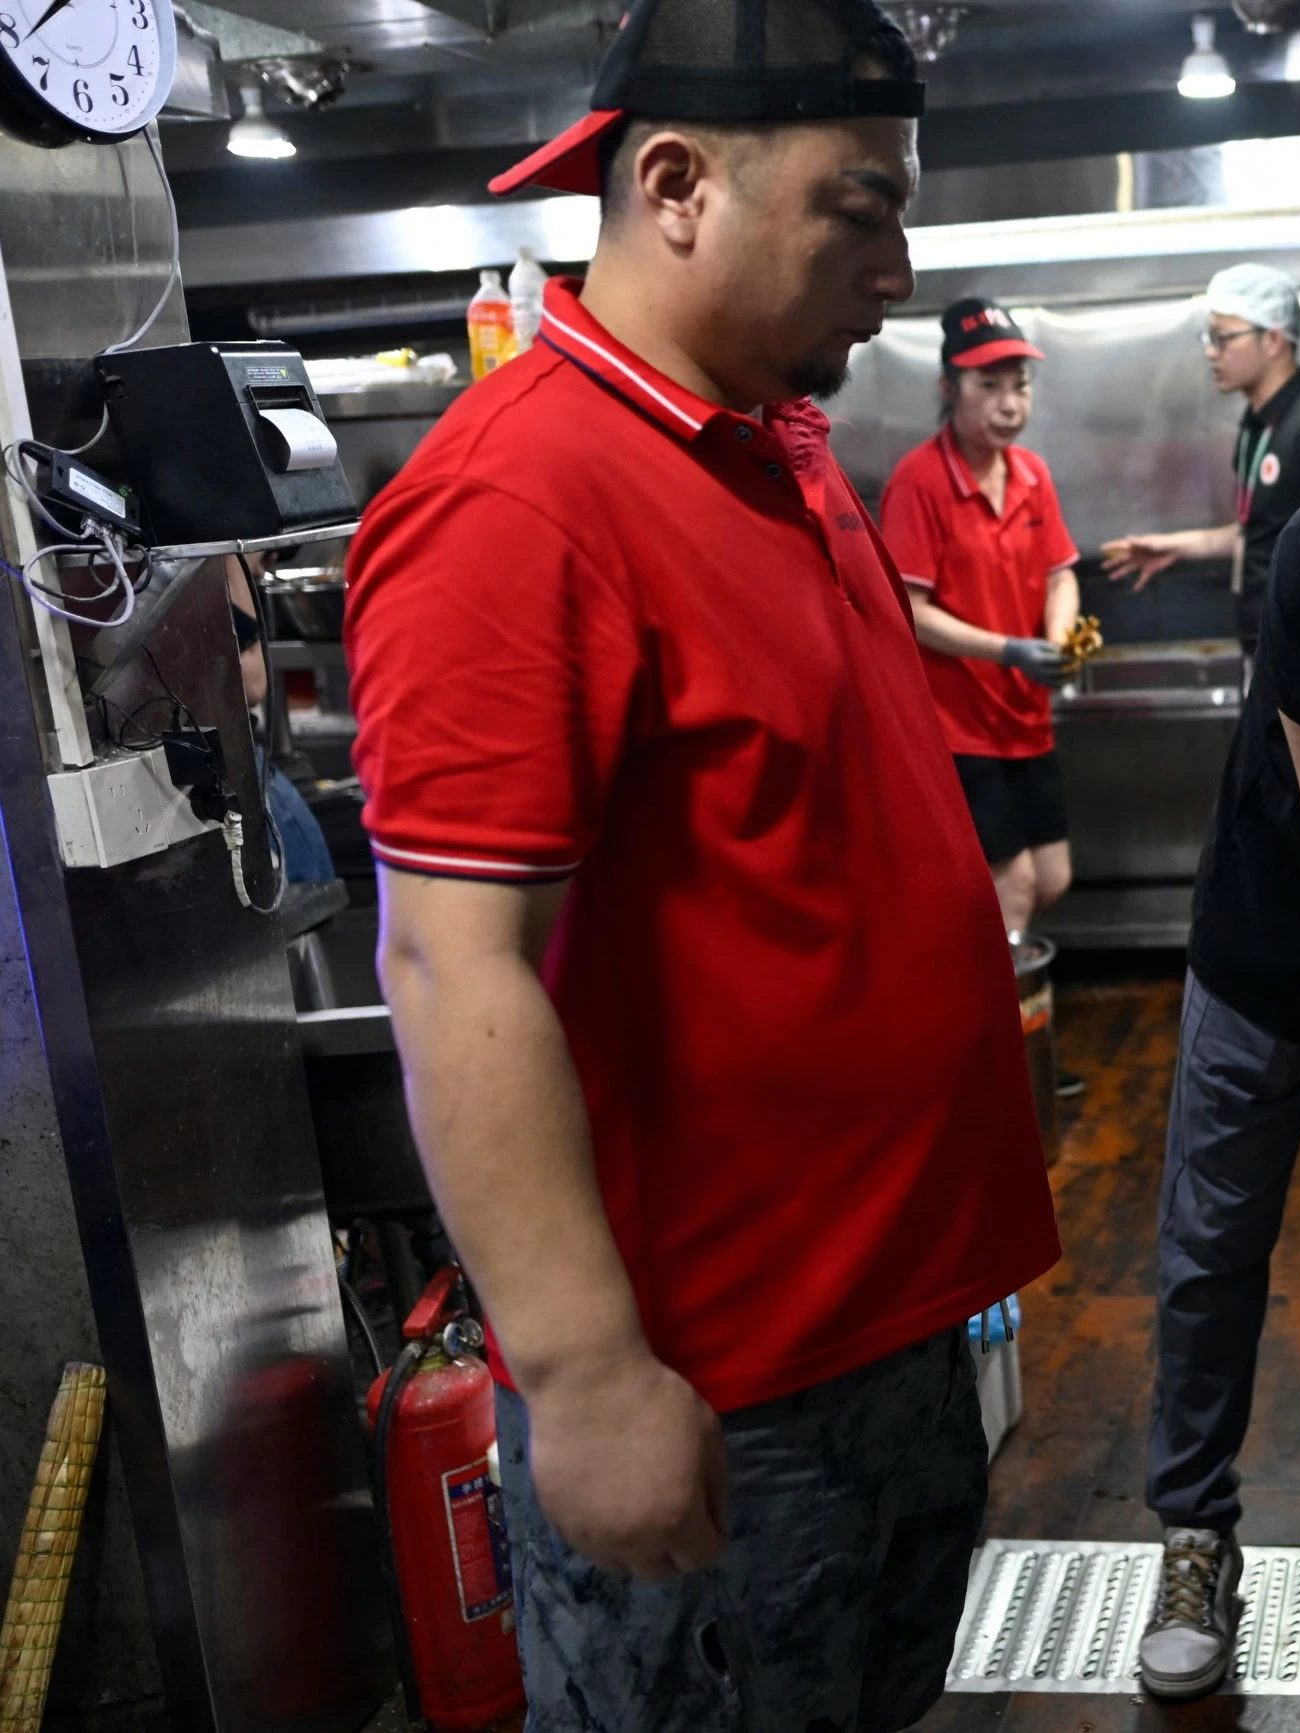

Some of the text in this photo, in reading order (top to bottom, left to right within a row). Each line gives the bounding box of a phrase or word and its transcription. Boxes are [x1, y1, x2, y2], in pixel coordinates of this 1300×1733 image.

[0, 13, 20, 49] 8
[130, 0, 149, 30] 3
[32, 54, 50, 91] 7
[127, 44, 145, 77] 4
[73, 79, 93, 113] 6
[109, 72, 129, 106] 5
